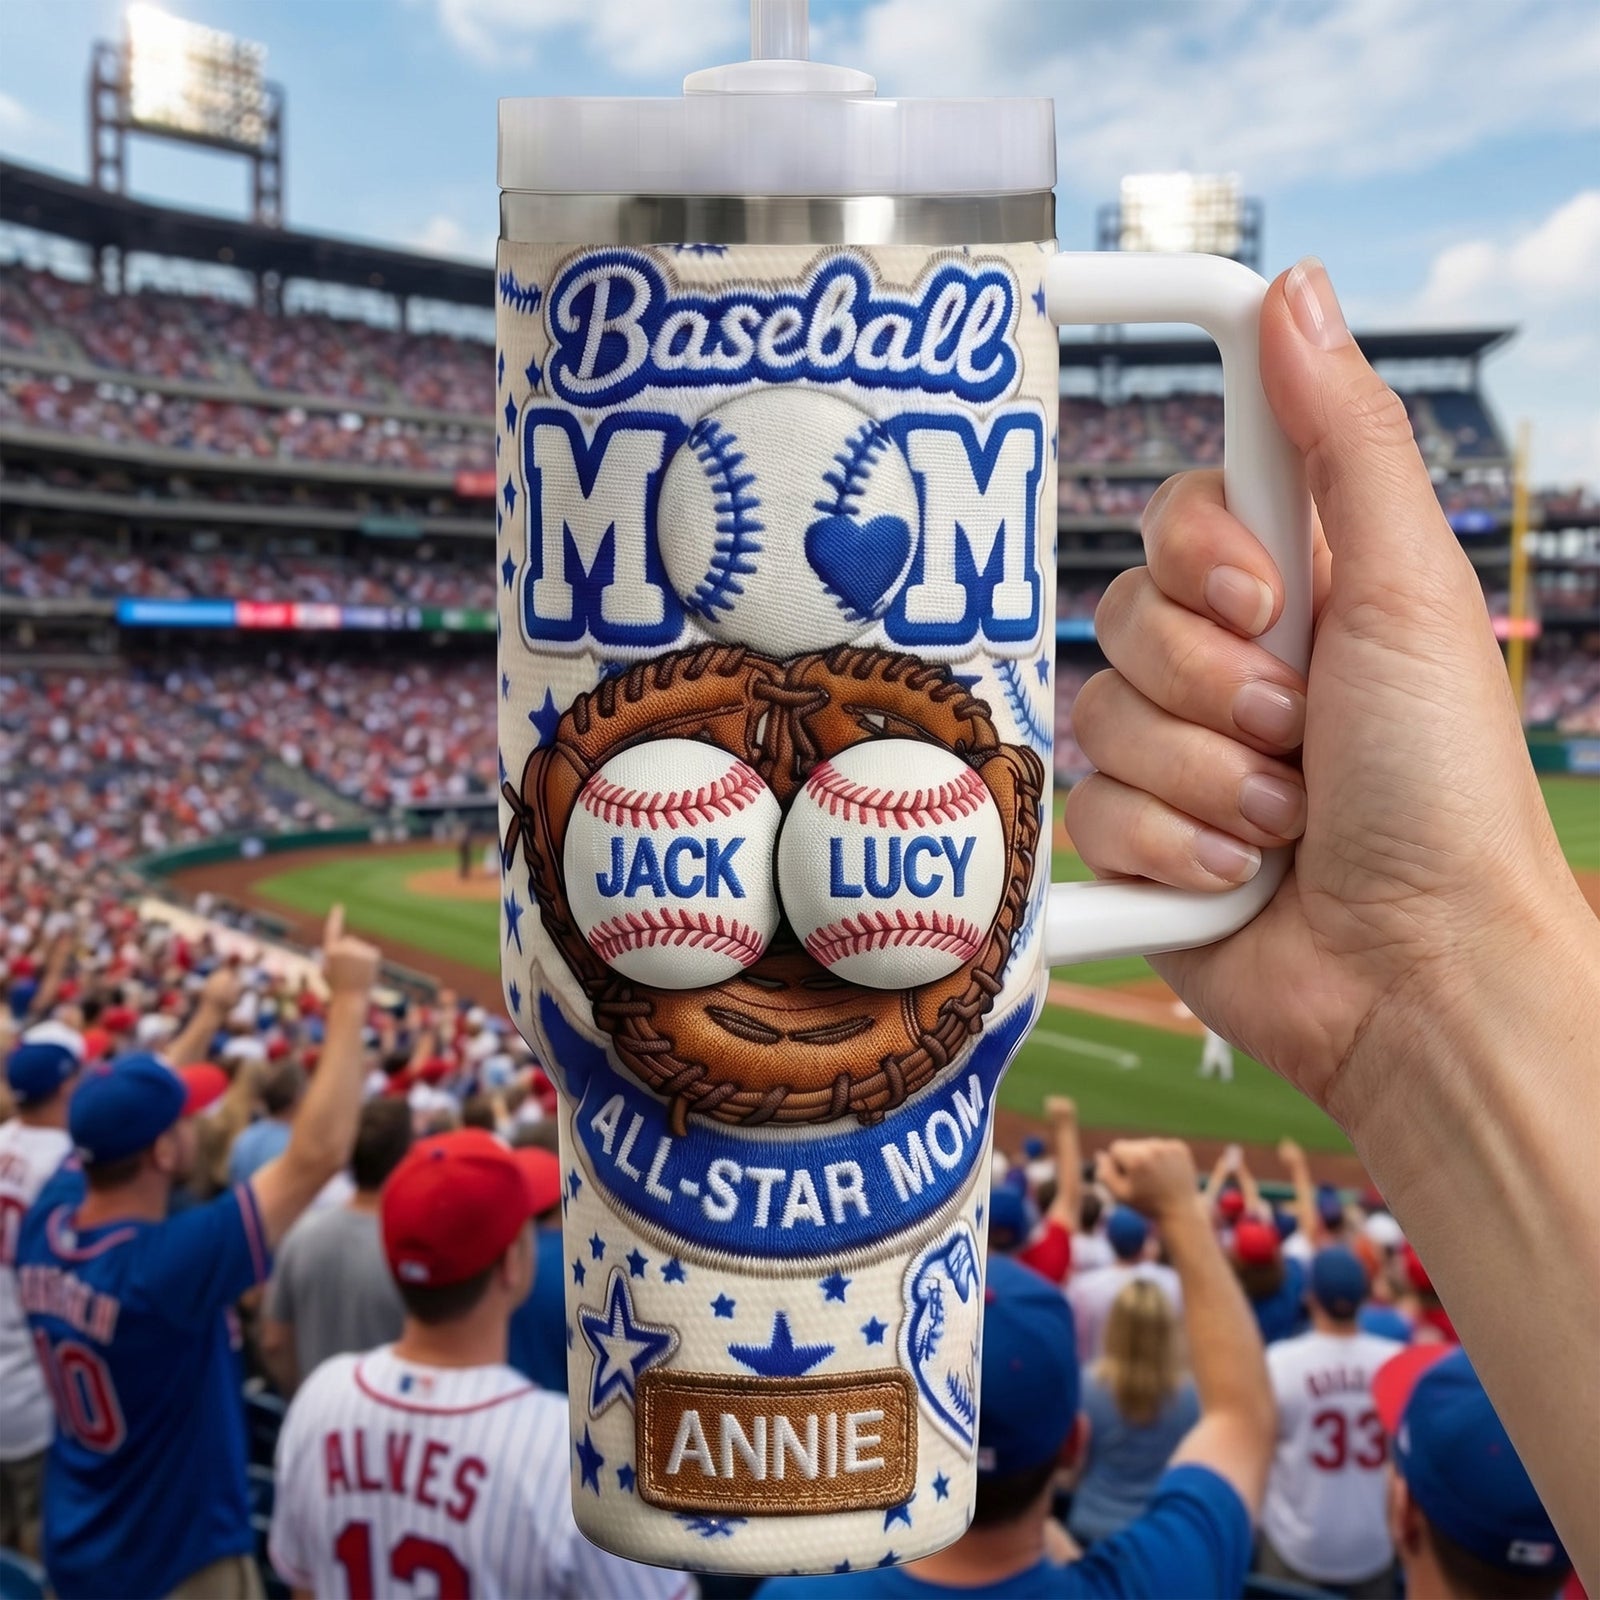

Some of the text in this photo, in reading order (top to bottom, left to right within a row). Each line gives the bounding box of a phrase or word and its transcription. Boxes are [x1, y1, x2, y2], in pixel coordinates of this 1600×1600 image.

[557, 263, 1006, 395] Baseball
[526, 390, 1042, 650] MOM
[596, 836, 746, 899] JACK
[829, 836, 977, 899] LUCY
[590, 1073, 985, 1229] ALL-STAR MOM
[325, 1427, 488, 1526] ALVES
[665, 1410, 885, 1481] ANNIE
[1310, 1407, 1387, 1471] 33
